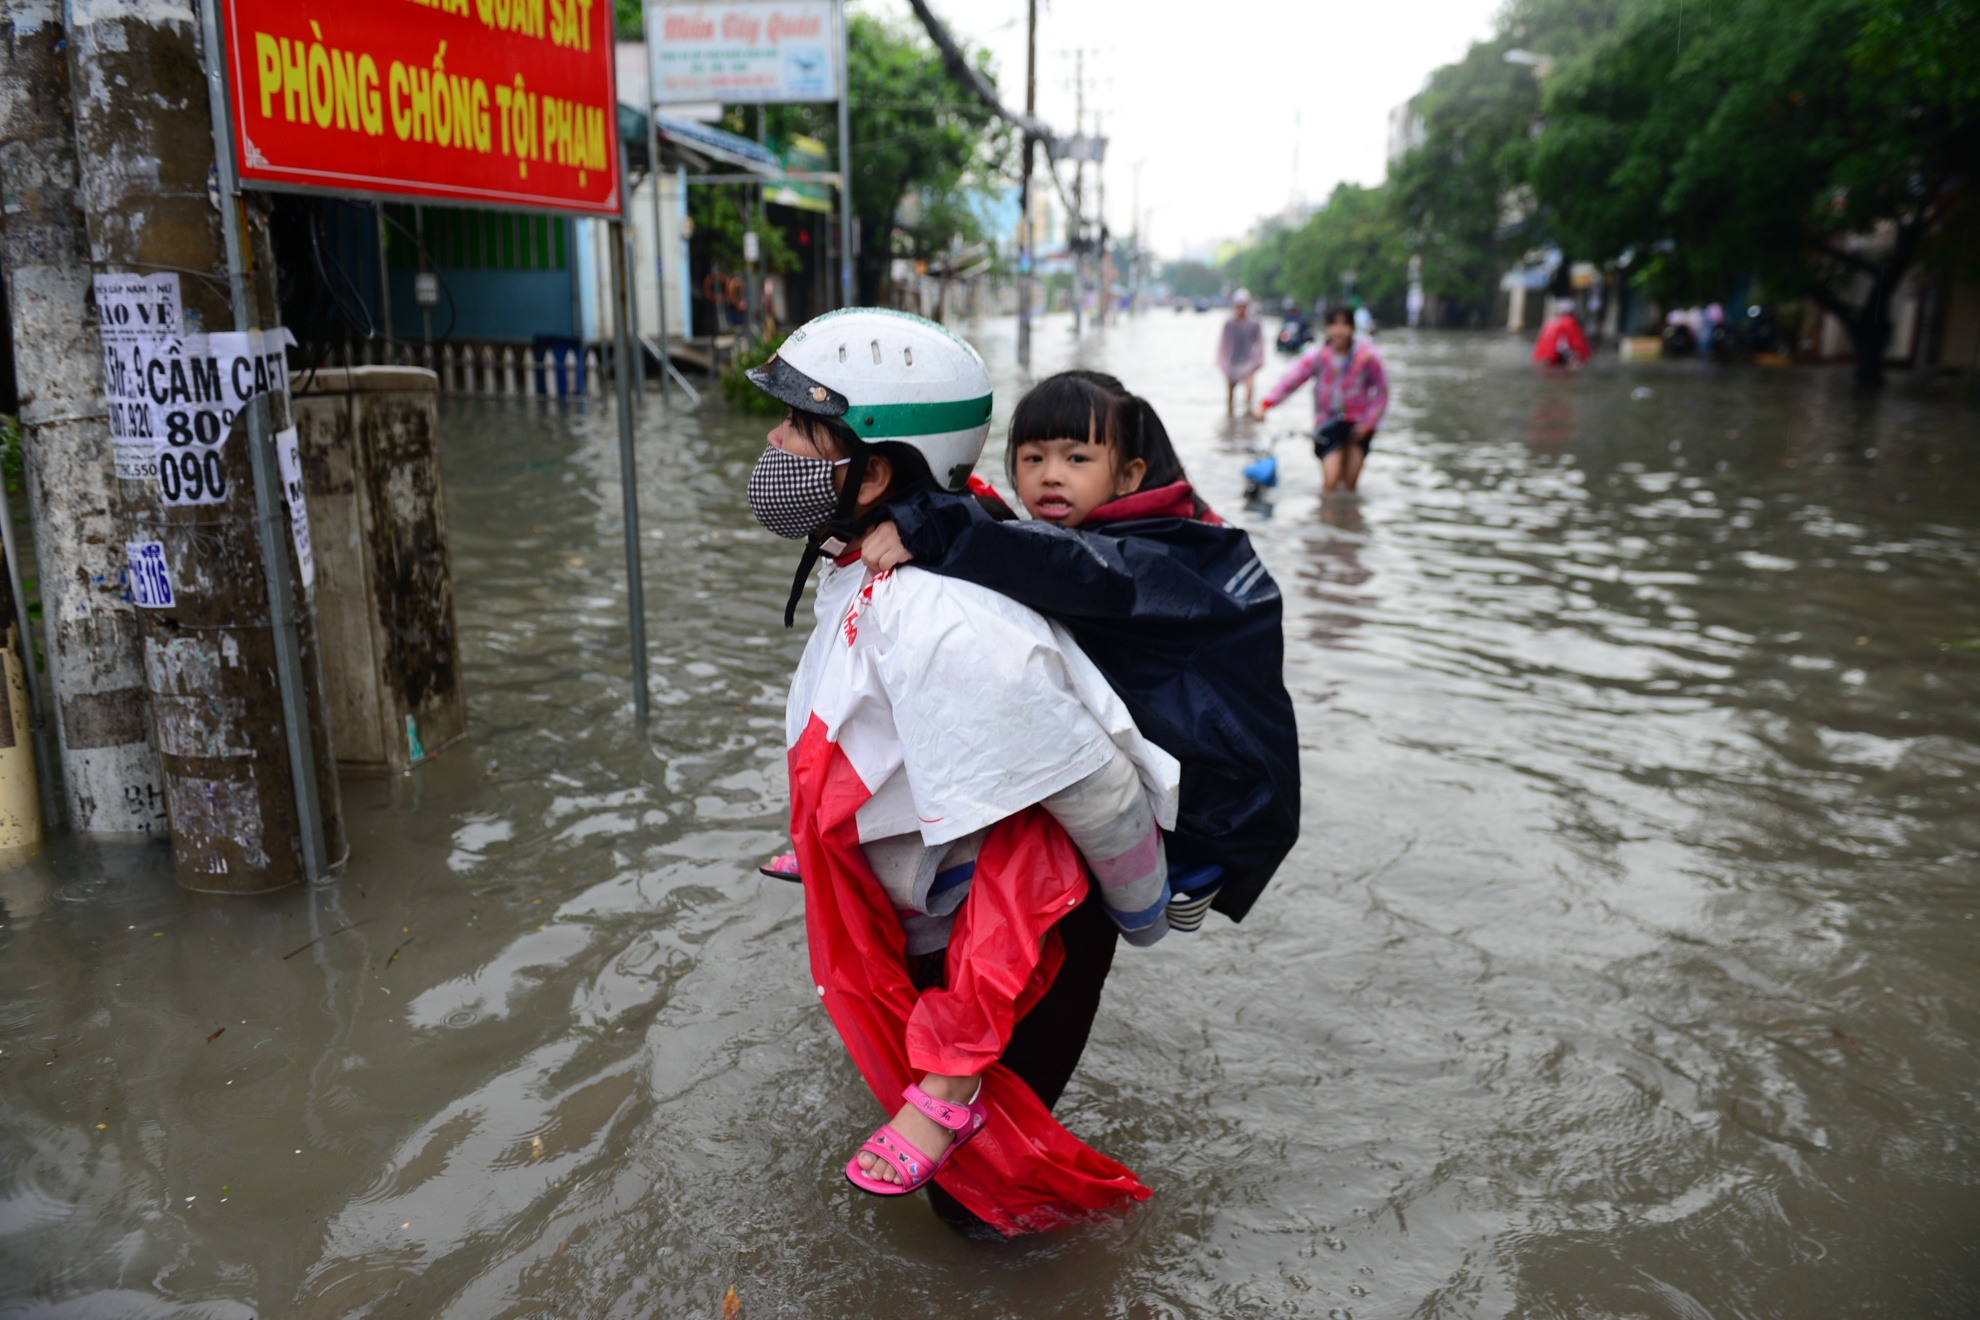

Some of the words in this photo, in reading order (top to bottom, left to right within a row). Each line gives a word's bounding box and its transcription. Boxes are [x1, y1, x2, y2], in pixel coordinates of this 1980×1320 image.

[255, 19, 384, 137] PHÒNG
[389, 40, 492, 154] CHỐNG
[496, 72, 538, 180] TỘI
[542, 96, 608, 188] PHẠM
[136, 295, 175, 329] VỆ
[147, 338, 223, 405] CẦM
[160, 449, 226, 501] 090
